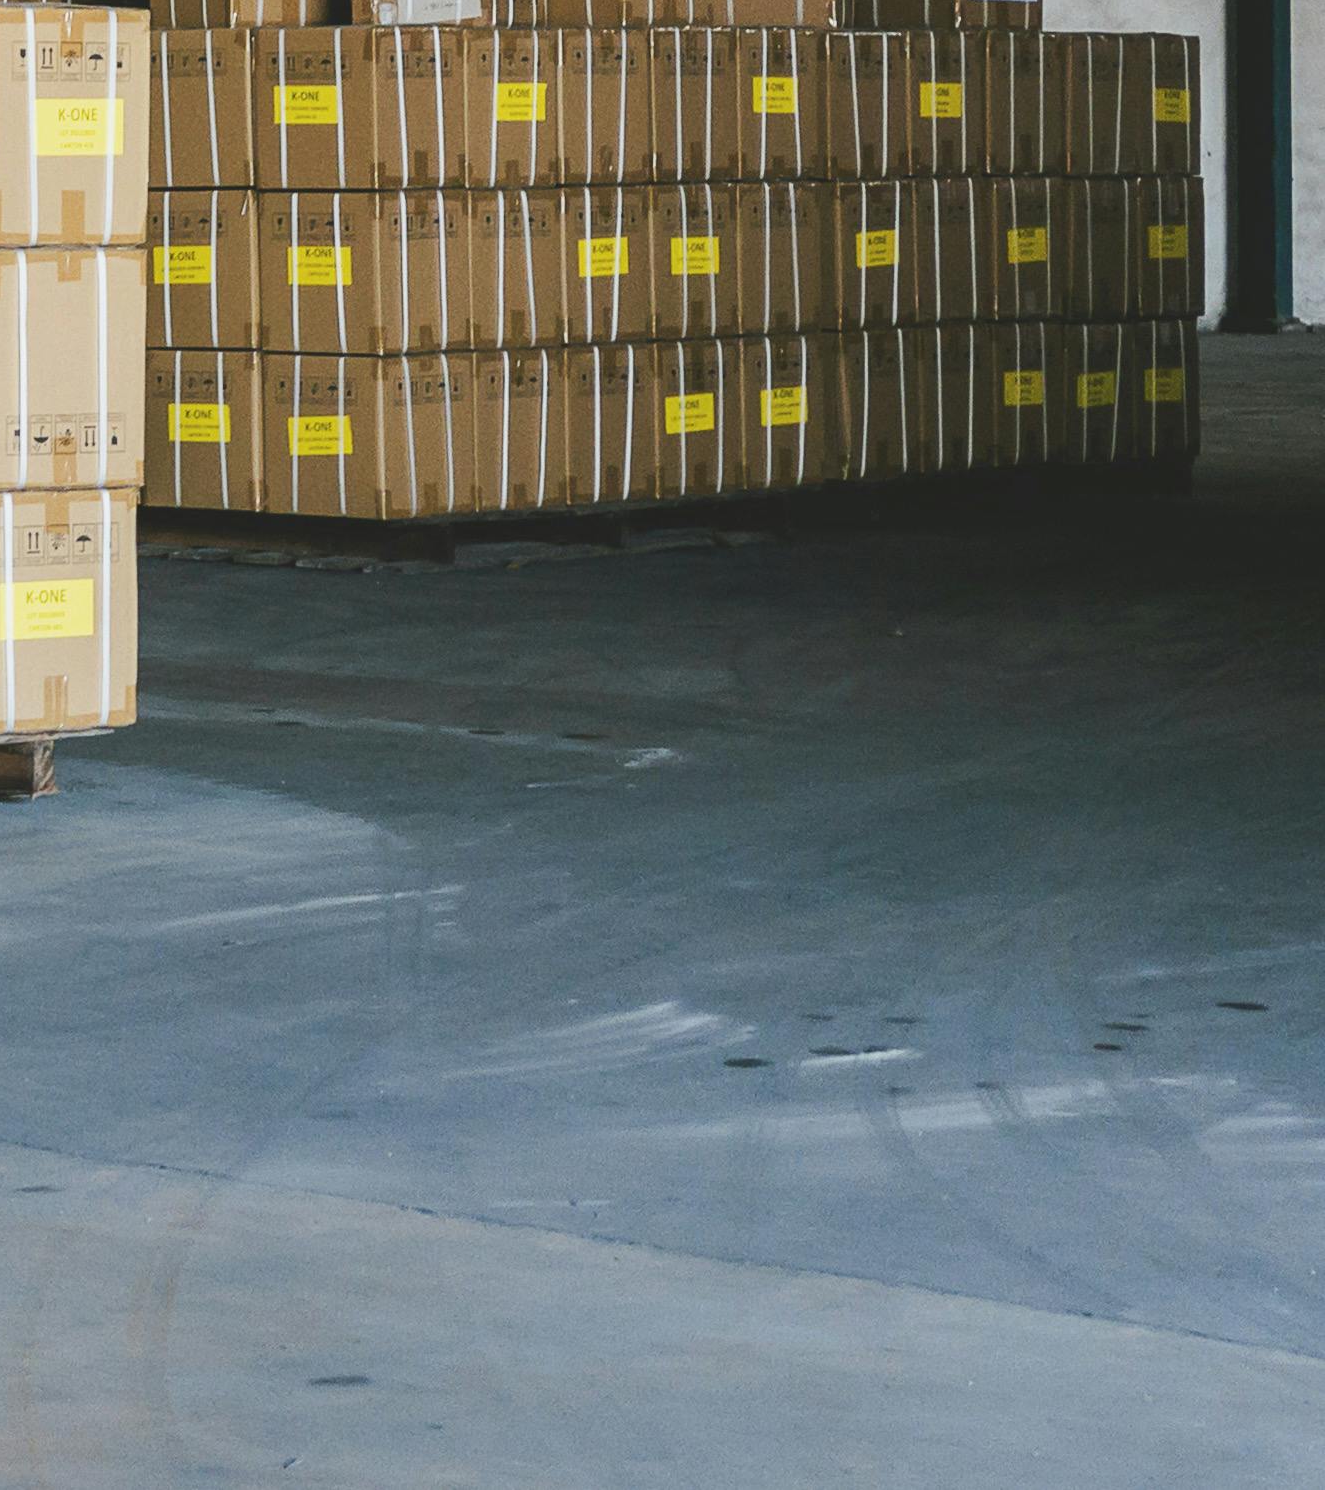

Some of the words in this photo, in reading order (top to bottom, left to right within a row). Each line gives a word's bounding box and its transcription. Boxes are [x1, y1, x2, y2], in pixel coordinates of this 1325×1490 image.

[291, 91, 320, 102] K-ONE
[507, 88, 530, 98] K-ONE
[57, 107, 98, 122] K-ONE
[169, 250, 196, 262] K-ONE
[305, 247, 333, 258] K-ONE
[184, 409, 212, 419] K-ONE
[304, 421, 332, 432] K-ONE
[26, 589, 67, 605] K-ONE
